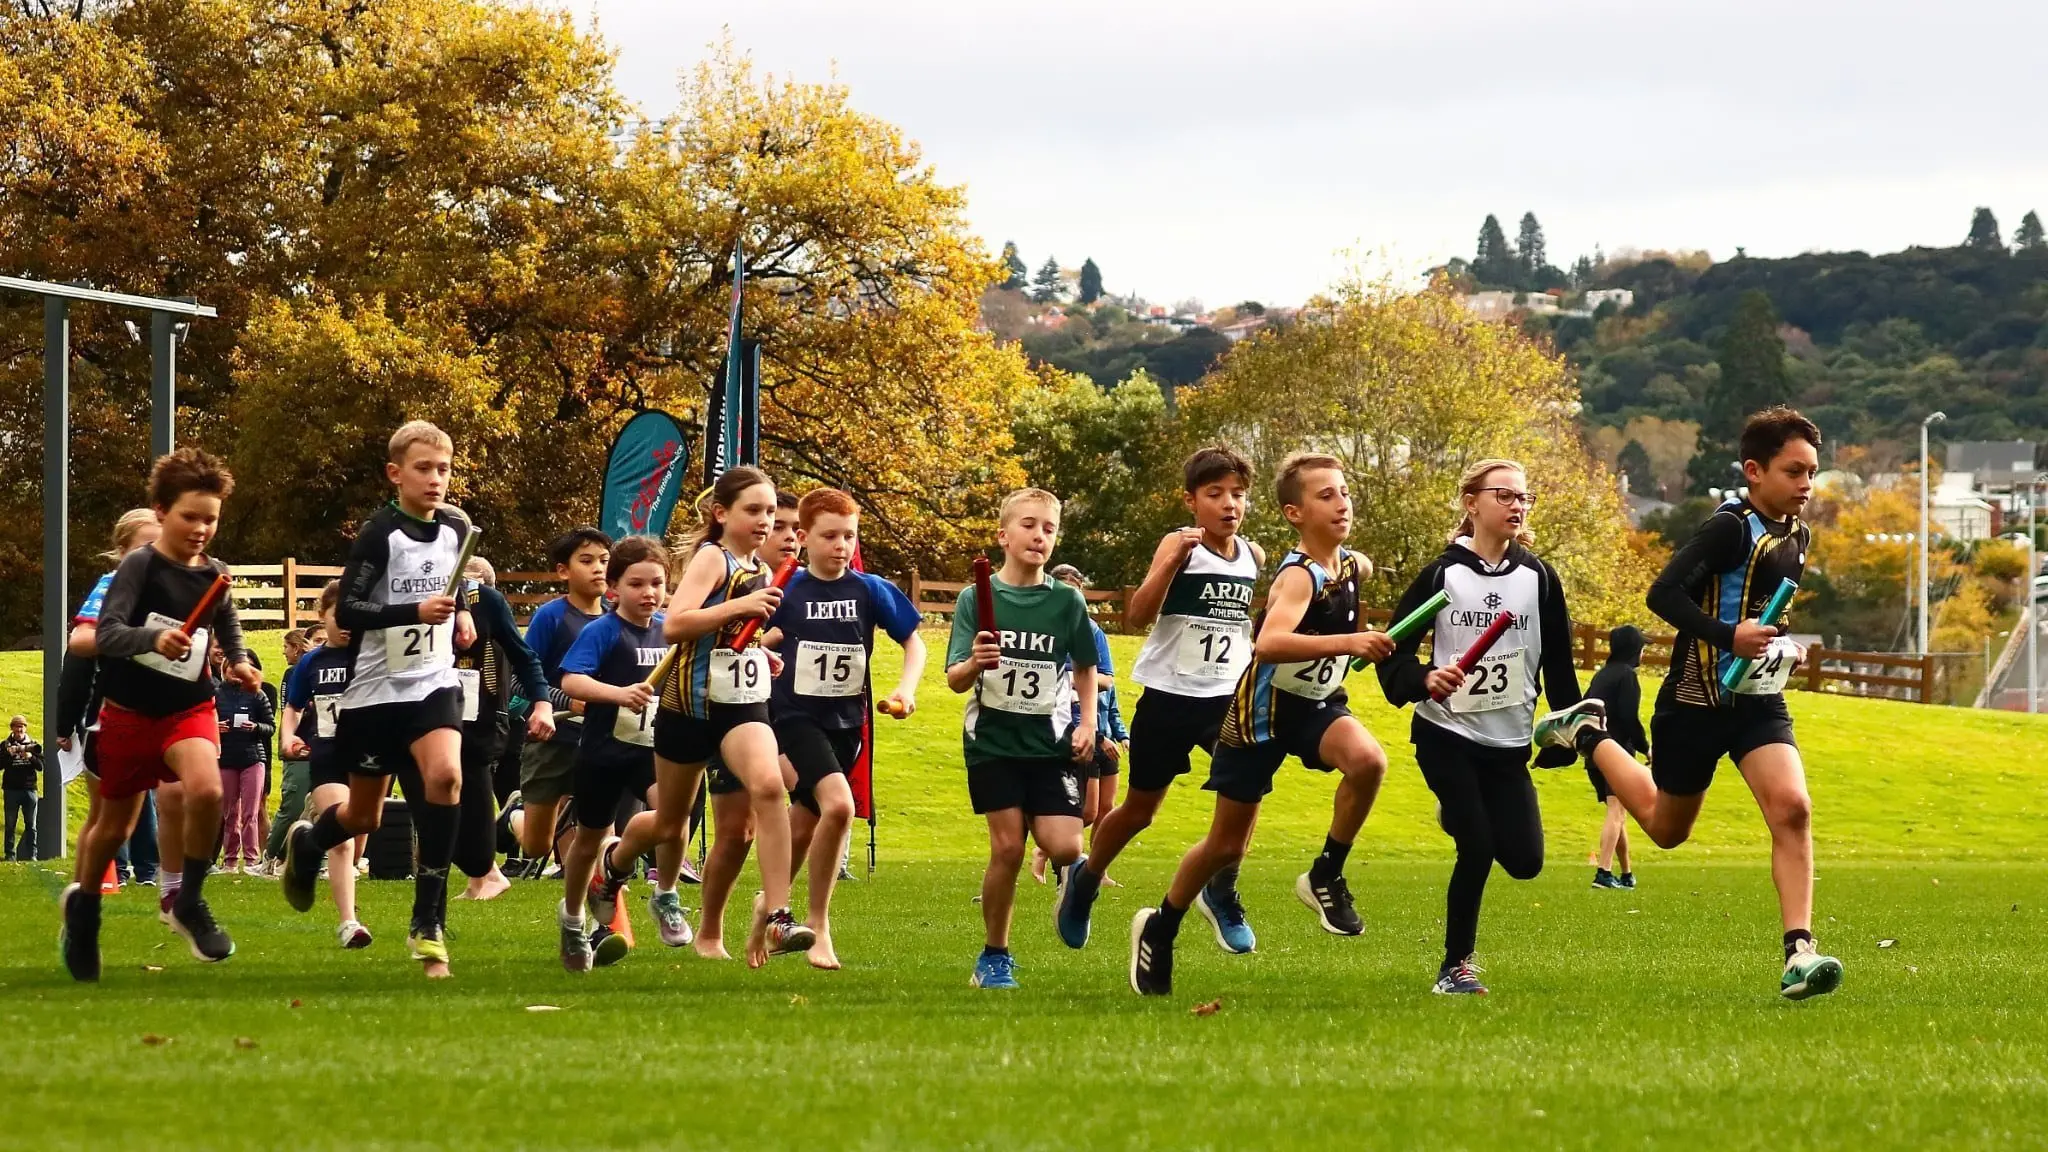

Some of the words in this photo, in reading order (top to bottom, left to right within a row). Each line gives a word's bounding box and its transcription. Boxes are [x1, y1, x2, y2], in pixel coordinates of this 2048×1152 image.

[391, 576, 450, 593] CAVERSHA
[806, 600, 858, 619] LEITH
[1208, 608, 1248, 619] ATHLETICS
[1450, 610, 1529, 630] CAVERAM
[1189, 624, 1224, 632] ATHLETICS
[403, 624, 434, 657] 21
[803, 644, 840, 652] ATHLETICS
[999, 630, 1055, 653] RIKI
[1200, 634, 1231, 664] 12
[1000, 659, 1030, 668] HLETICS
[1031, 662, 1054, 670] OTAGO
[1498, 652, 1519, 660] OTAGO
[1749, 650, 1784, 679] 24
[728, 659, 758, 689] 19
[814, 653, 851, 683] 15
[1294, 655, 1338, 685] 26
[1468, 663, 1509, 696] 23
[1002, 668, 1041, 699] 13
